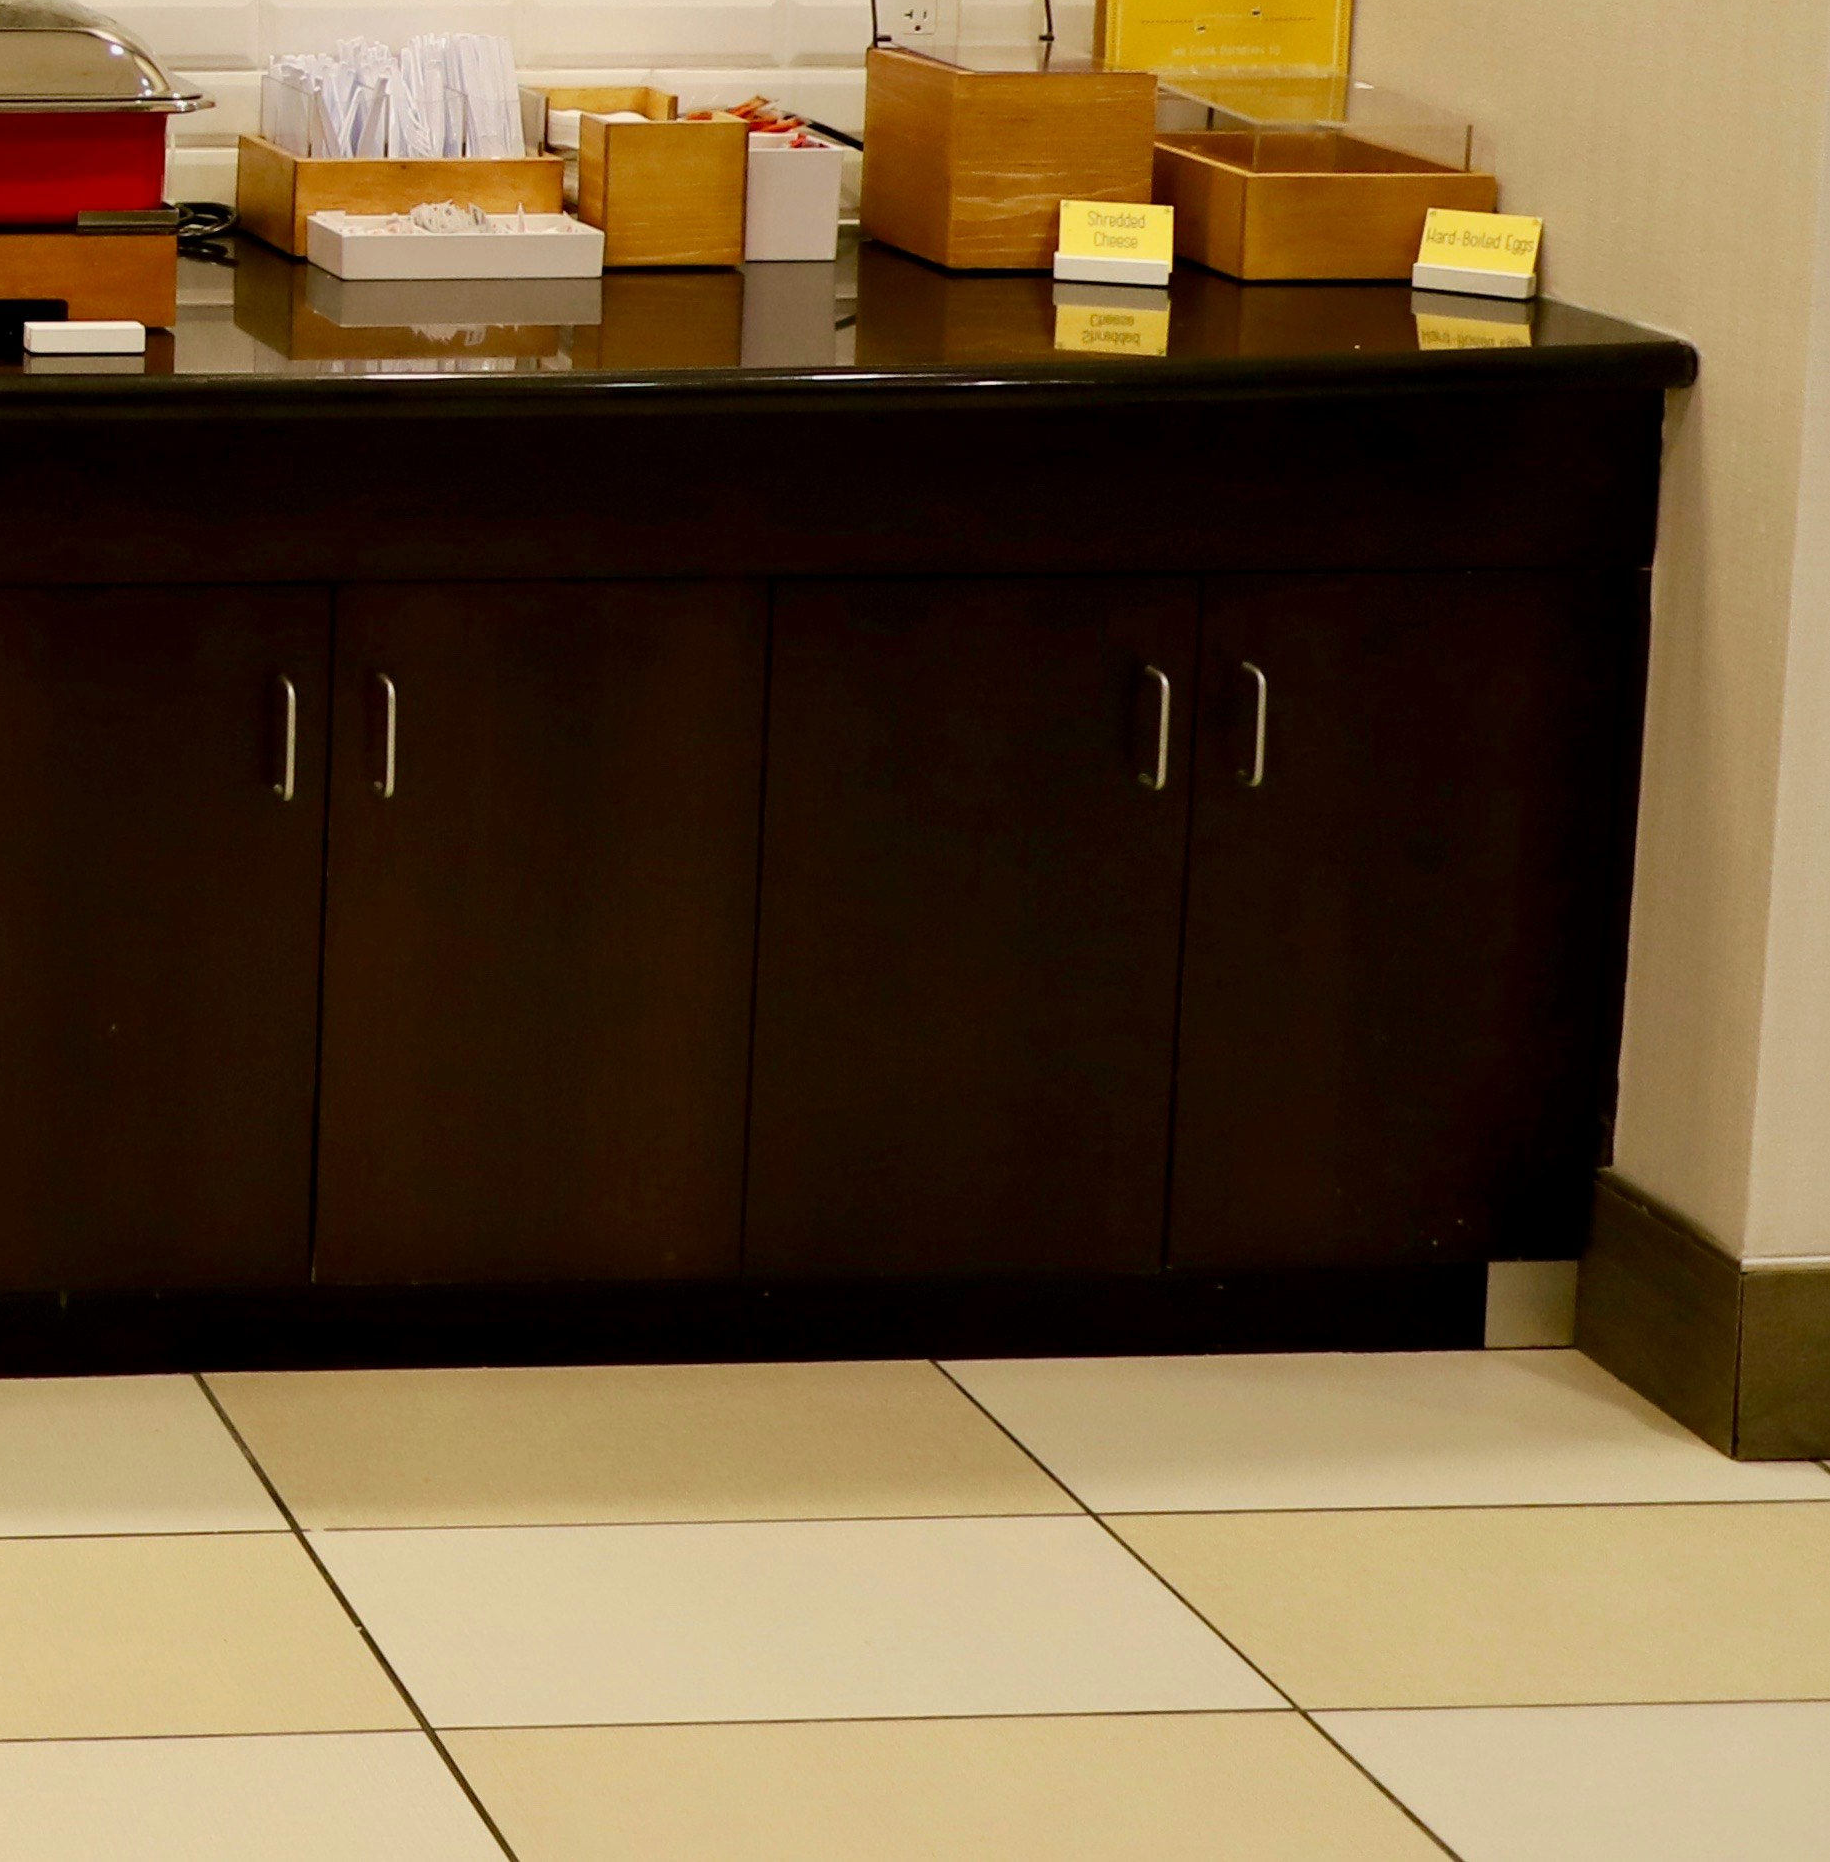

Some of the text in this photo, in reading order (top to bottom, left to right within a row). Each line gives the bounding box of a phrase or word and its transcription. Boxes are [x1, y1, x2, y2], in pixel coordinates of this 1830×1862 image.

[1087, 210, 1146, 229] Shredded
[1093, 231, 1139, 249] Cheese
[1426, 228, 1535, 256] Hard-Boiled Eggs
